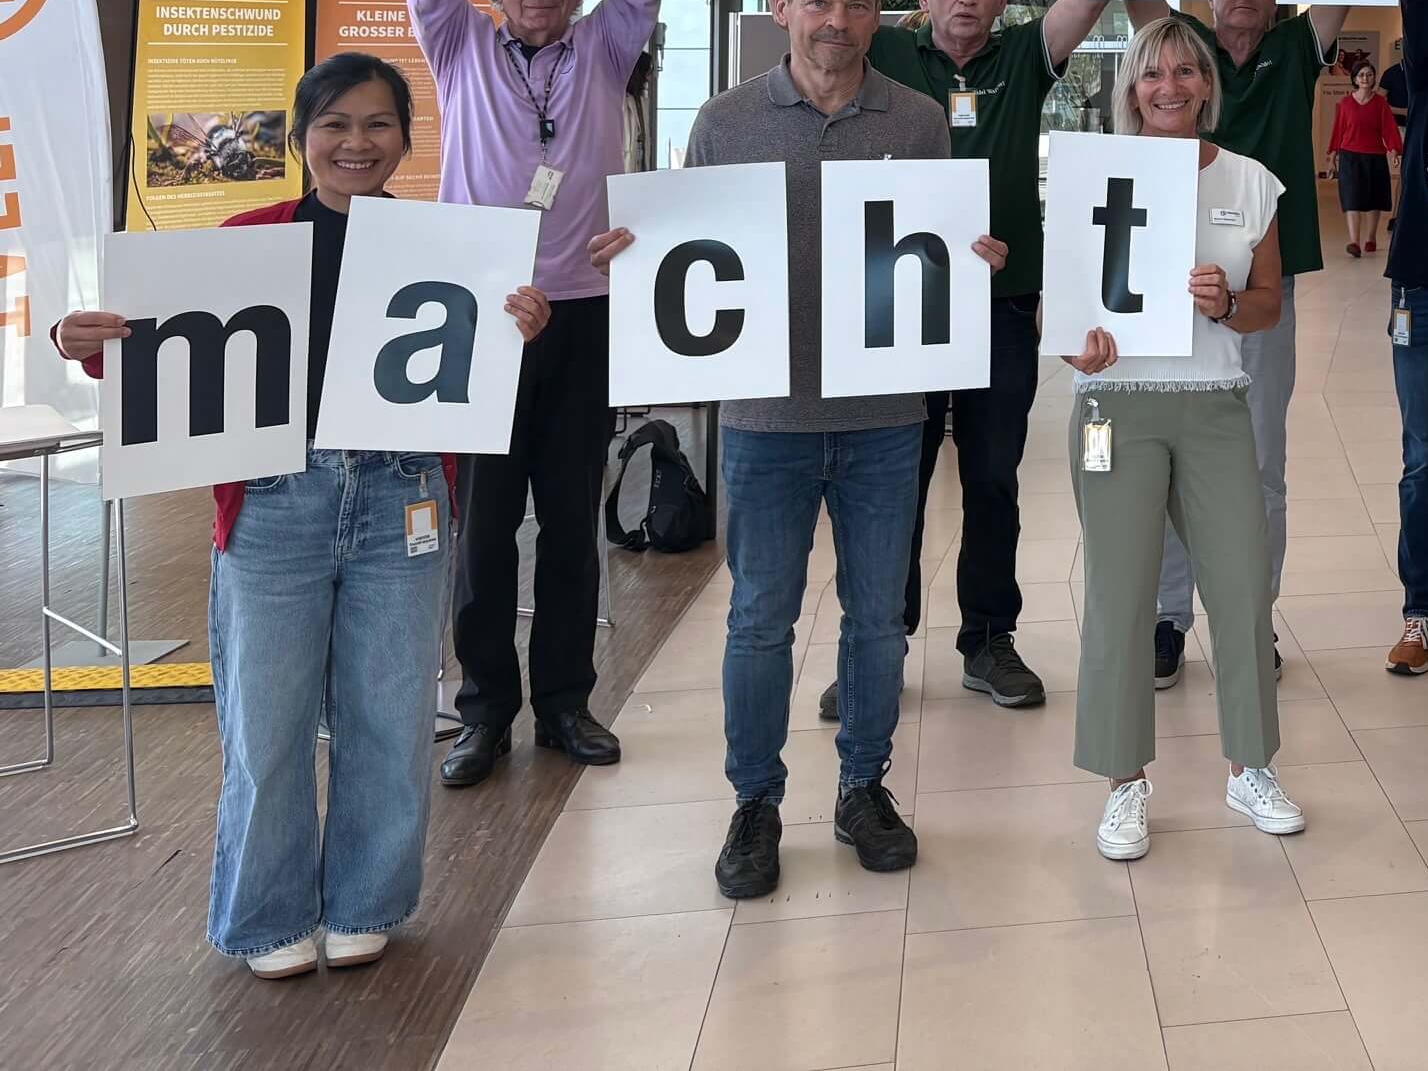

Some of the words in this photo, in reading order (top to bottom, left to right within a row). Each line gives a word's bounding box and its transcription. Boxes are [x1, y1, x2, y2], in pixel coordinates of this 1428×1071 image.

[155, 5, 281, 21] INSEKTENSCHWUND
[356, 9, 406, 22] KLEINE
[163, 24, 208, 36] DURCH
[212, 24, 274, 37] PESTIZIDE
[338, 25, 404, 38] GROSSER
